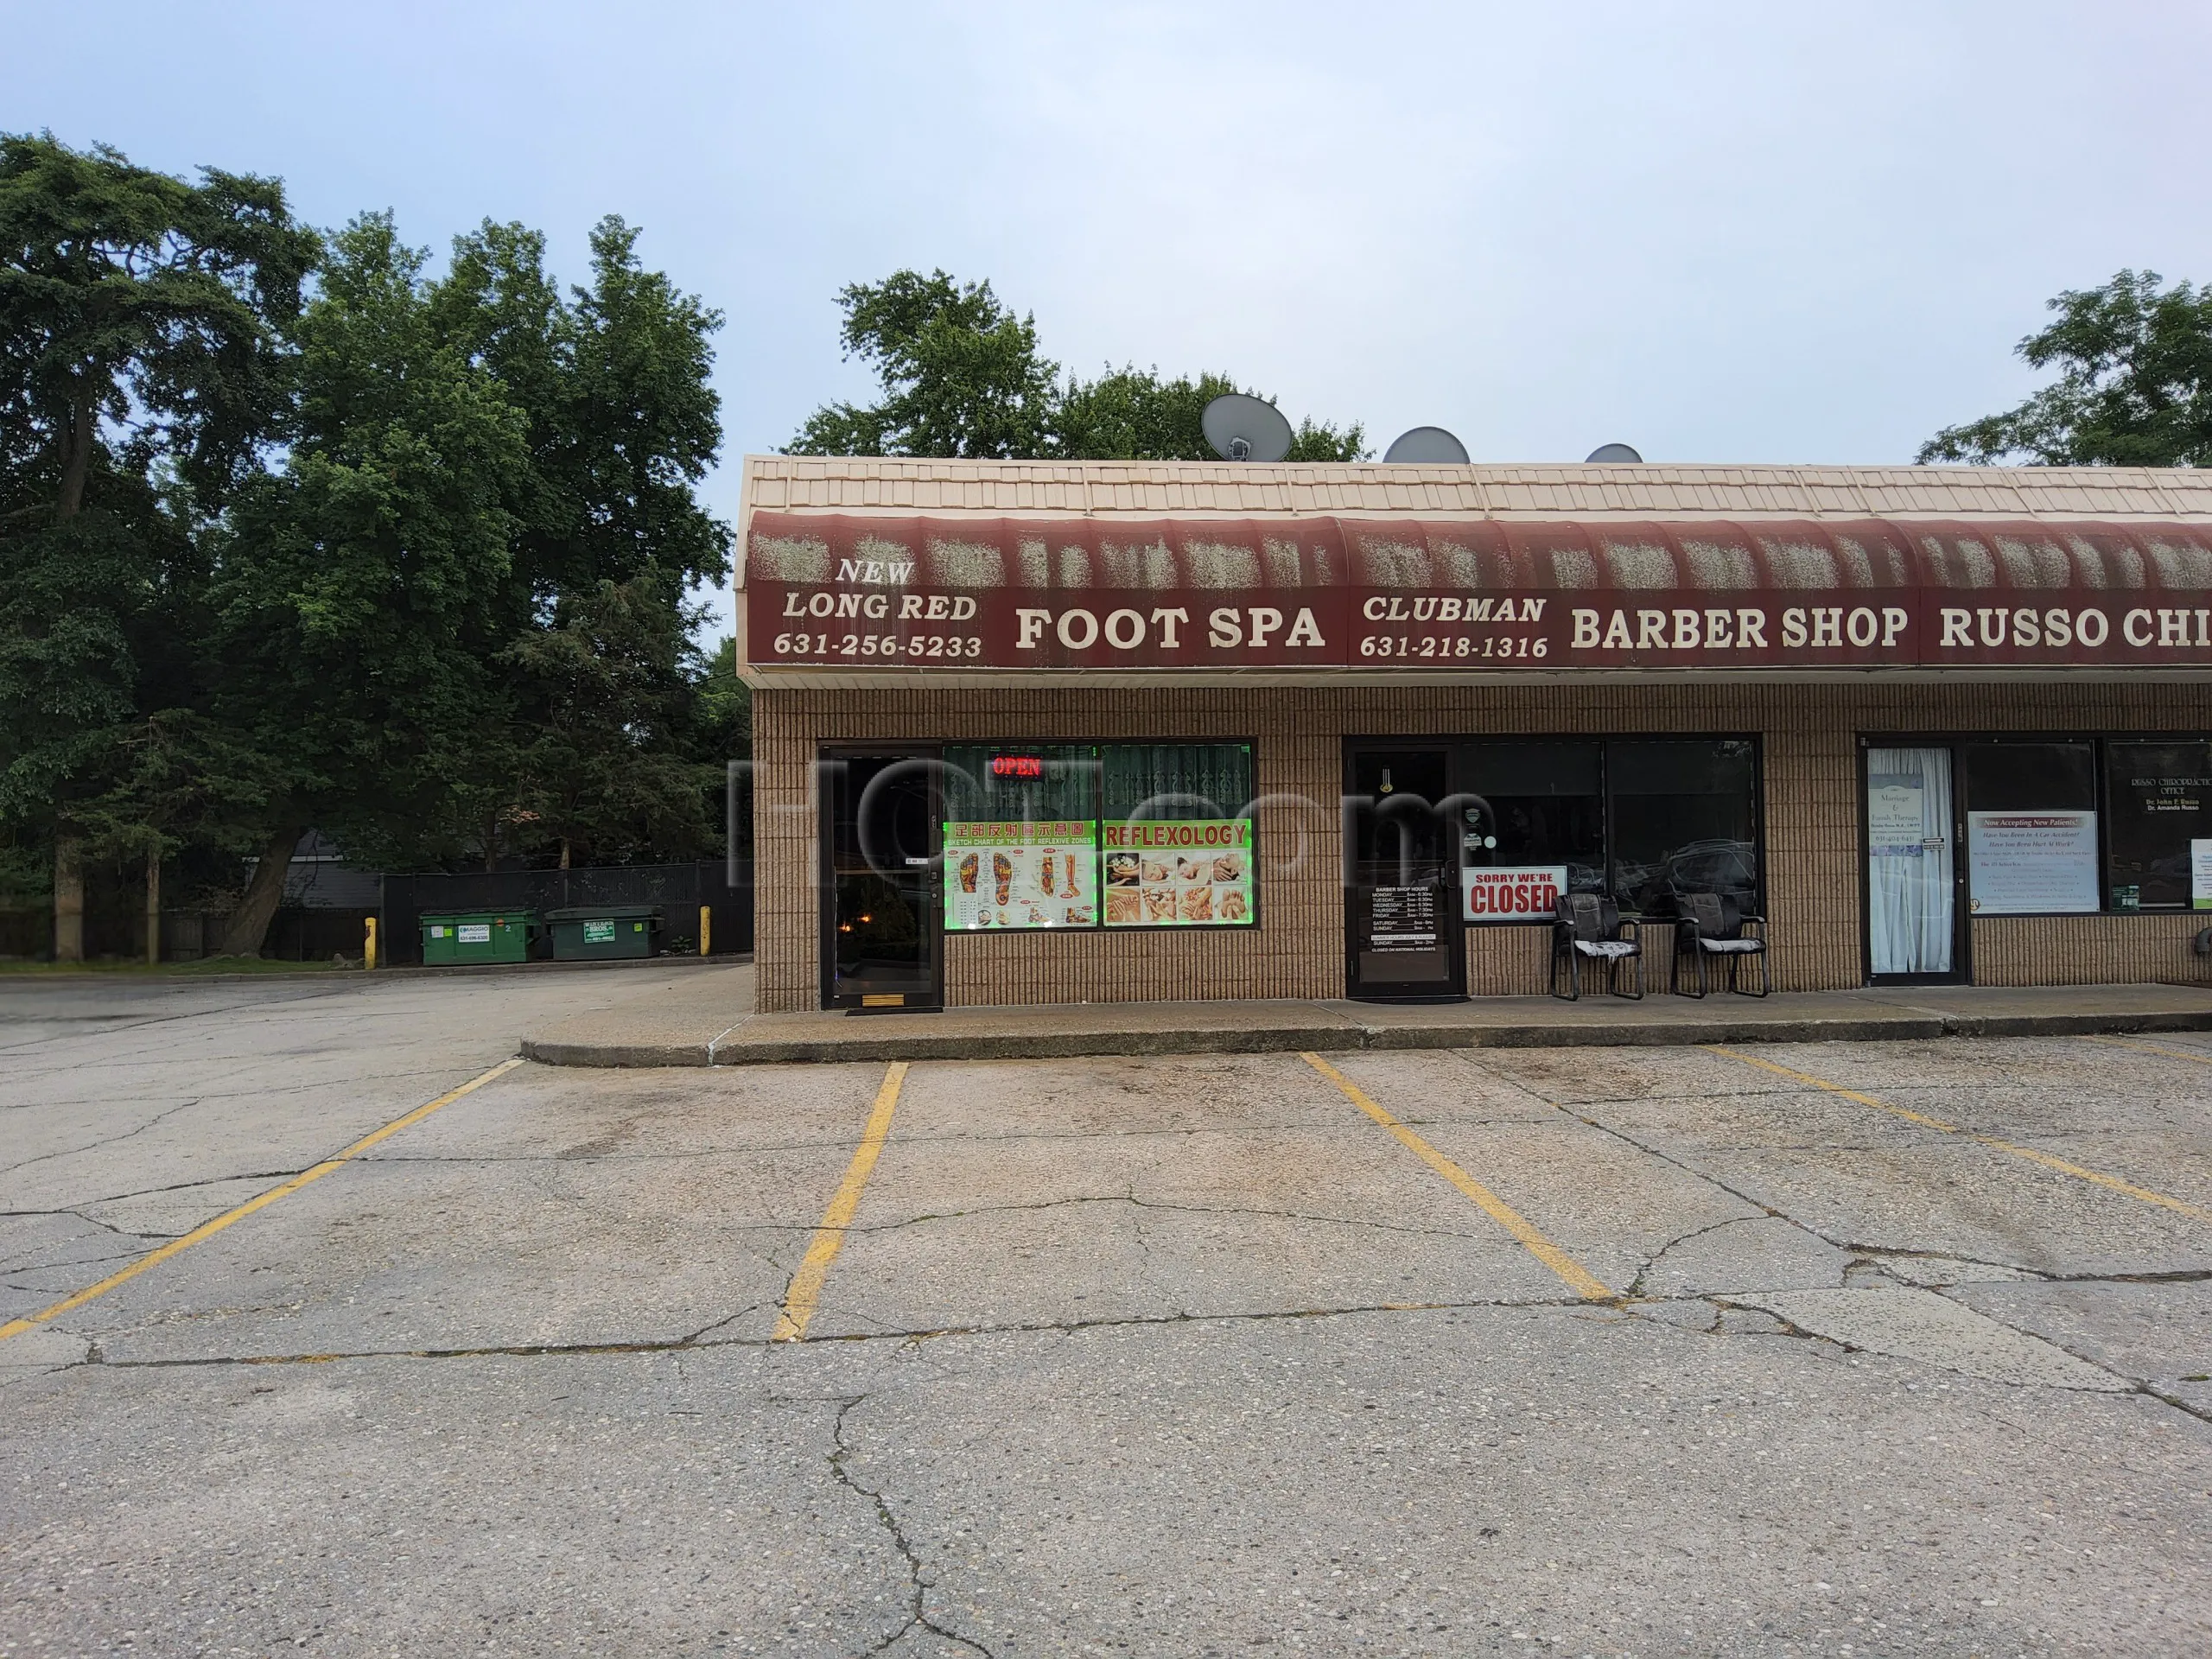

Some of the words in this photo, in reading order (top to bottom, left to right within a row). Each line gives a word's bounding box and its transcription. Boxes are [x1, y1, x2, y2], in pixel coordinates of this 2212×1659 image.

[835, 558, 914, 584] NEW
[782, 592, 889, 619] LONG
[898, 594, 976, 620] RED
[1363, 596, 1547, 622] CLUBMAN
[1015, 607, 1190, 650] FOOT
[1208, 607, 1325, 648] SPA
[1570, 608, 1769, 649] BARBER
[1781, 607, 1909, 648] SHOP
[1939, 607, 2109, 647] RUSSO
[773, 633, 982, 658] 631-256-5233
[1360, 636, 1548, 658] 631-218-1316
[993, 757, 1041, 776] OPEN
[1105, 824, 1247, 846] REFLEXOLOGY
[1476, 874, 1515, 883] SORRY
[1517, 873, 1553, 882] WE'RE
[1471, 884, 1558, 913] CLOSED
